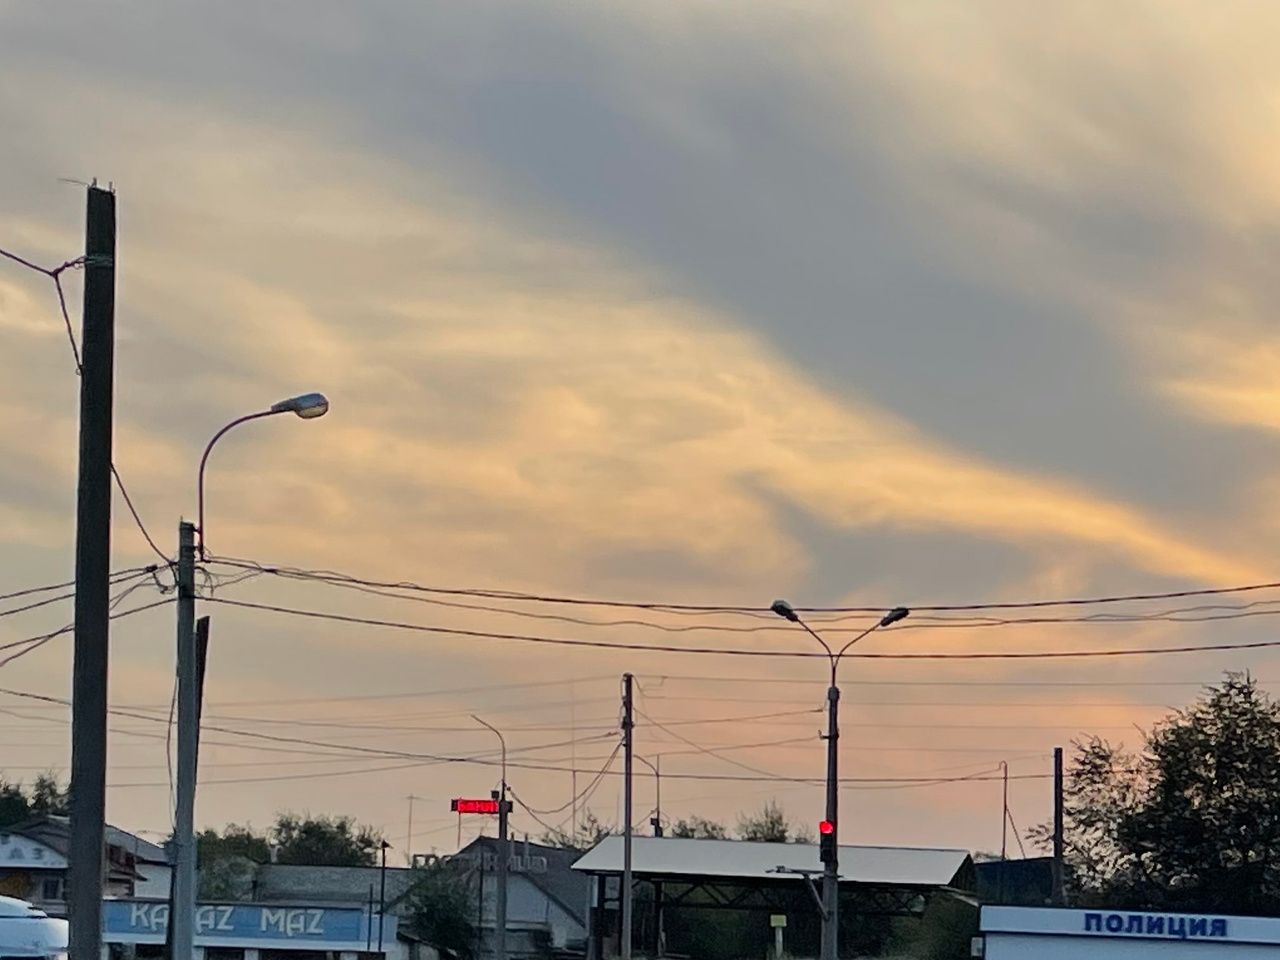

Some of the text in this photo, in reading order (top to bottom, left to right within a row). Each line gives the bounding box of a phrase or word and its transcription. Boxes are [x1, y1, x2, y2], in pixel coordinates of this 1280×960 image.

[131, 903, 324, 936] KAAZ MAZ
[1084, 913, 1228, 940] ПОЛИЦИЯ
